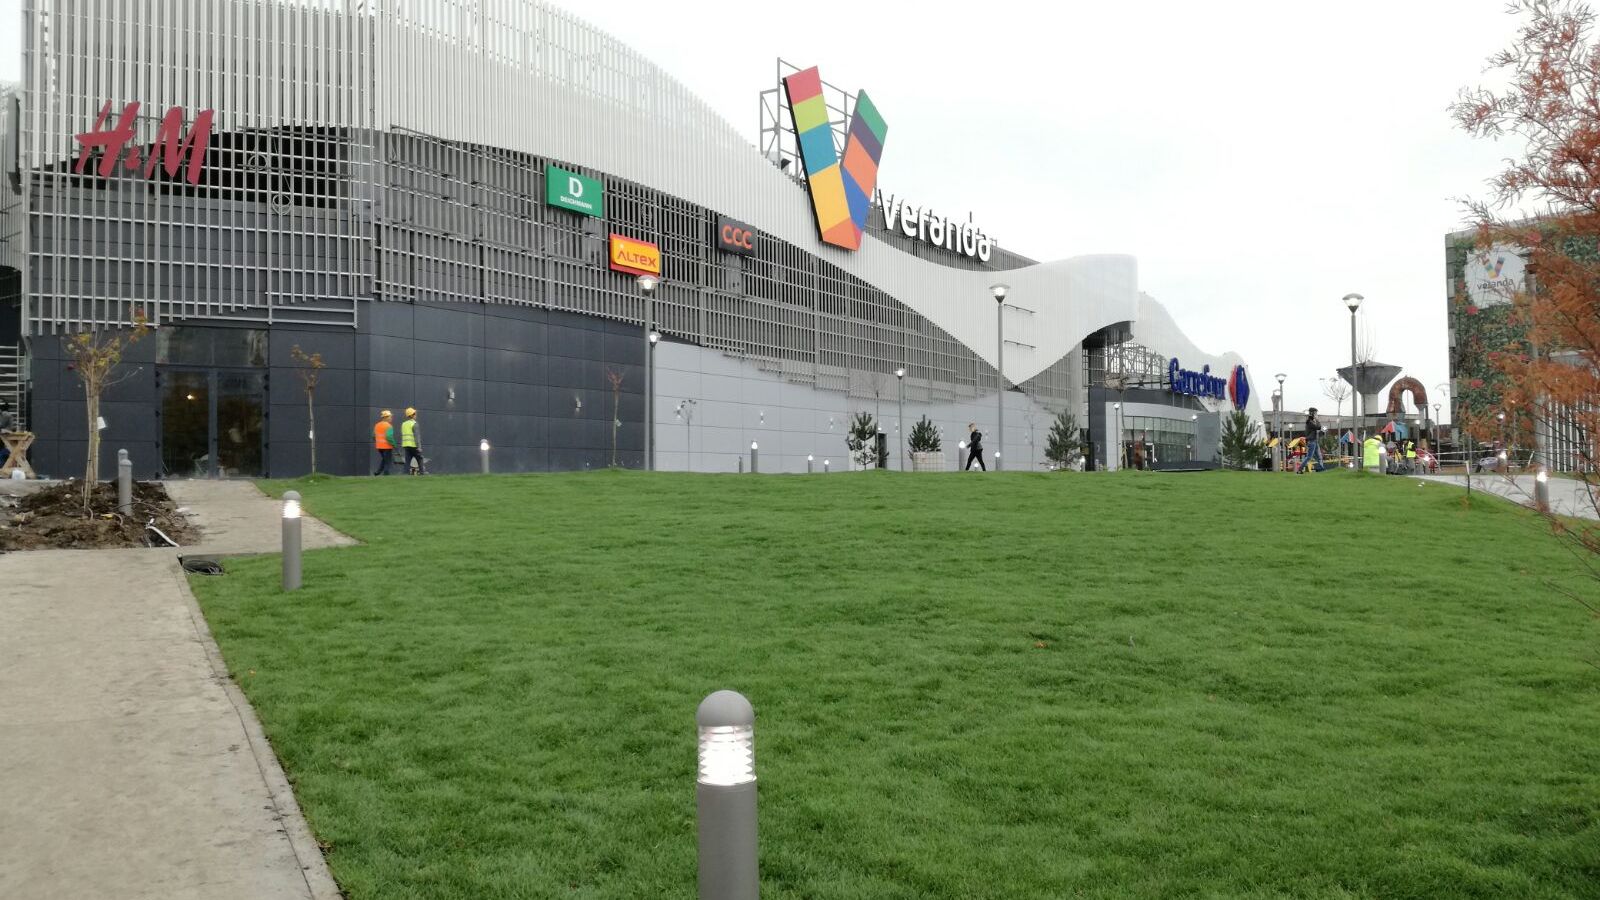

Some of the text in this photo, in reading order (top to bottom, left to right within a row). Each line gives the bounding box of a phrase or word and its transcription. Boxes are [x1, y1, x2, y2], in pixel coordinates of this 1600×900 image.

[75, 99, 214, 186] H&M
[569, 176, 583, 198] D
[722, 224, 753, 250] CCC
[879, 190, 992, 262] veranda
[1168, 357, 1227, 400] Carrefour
